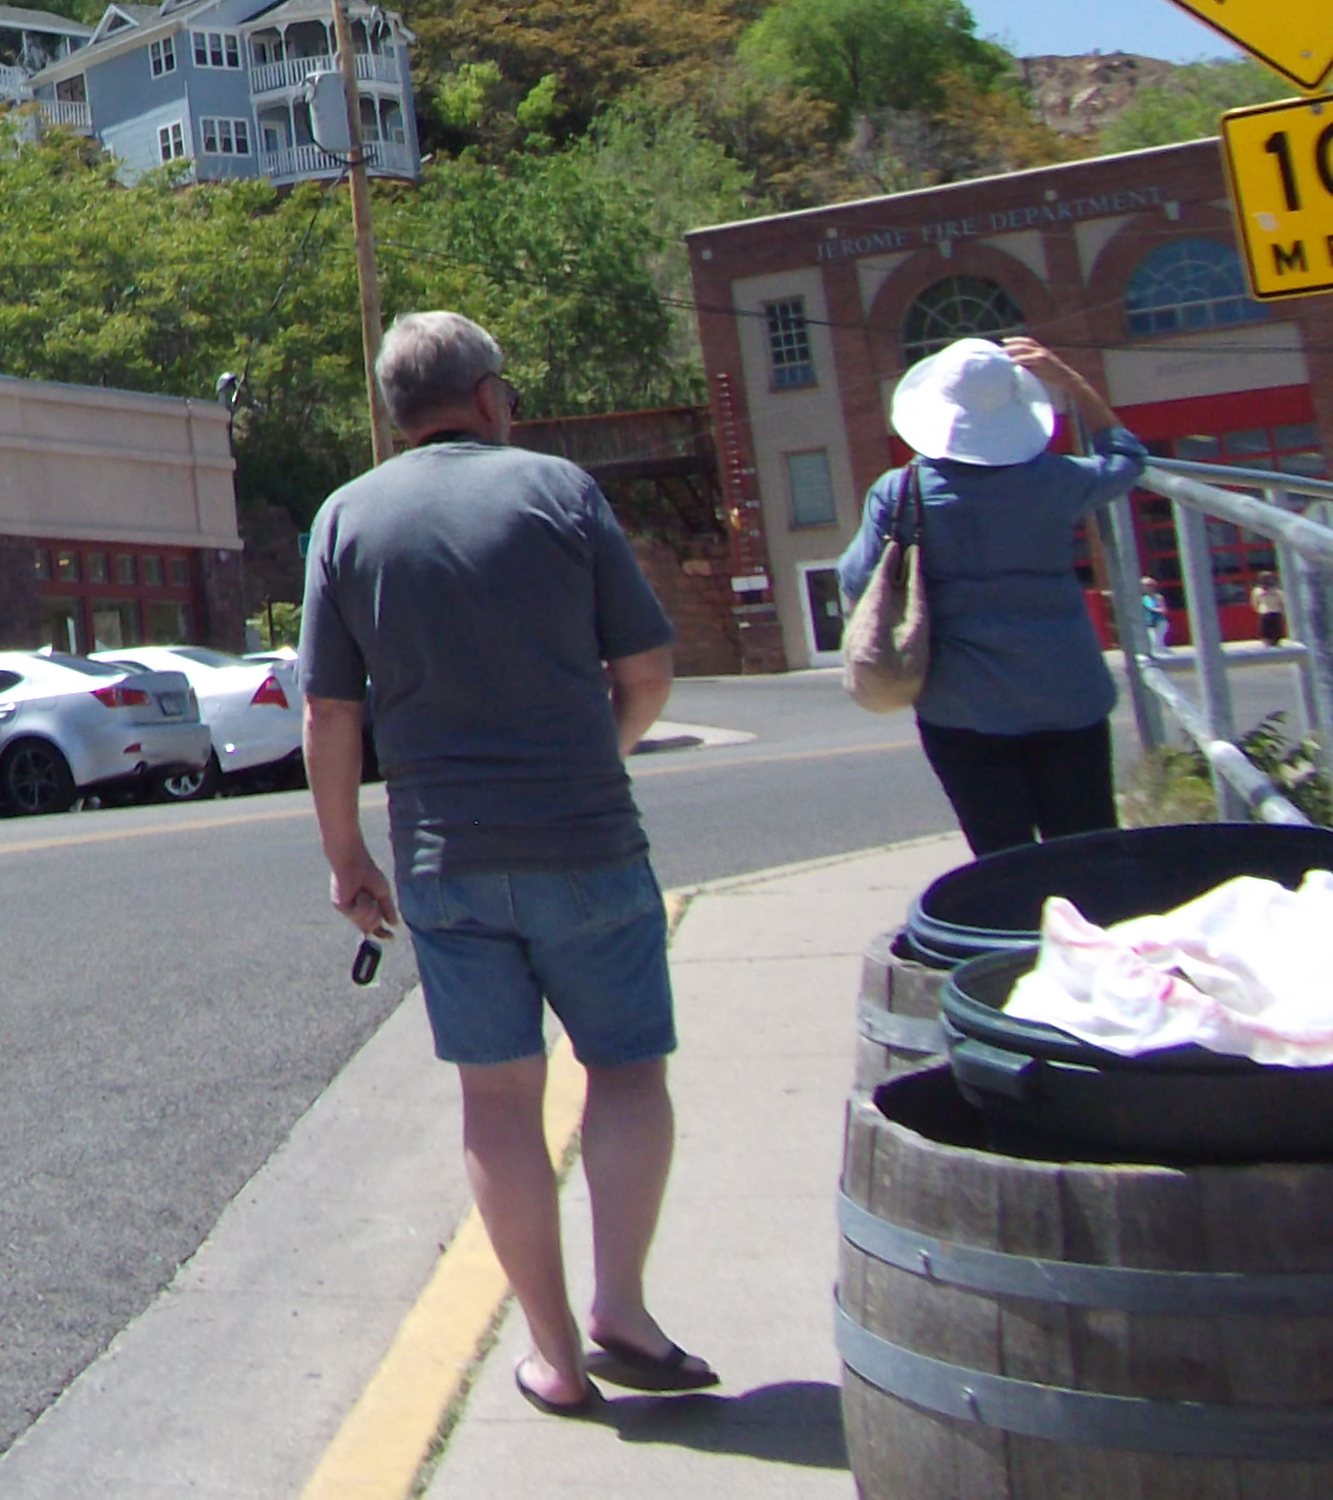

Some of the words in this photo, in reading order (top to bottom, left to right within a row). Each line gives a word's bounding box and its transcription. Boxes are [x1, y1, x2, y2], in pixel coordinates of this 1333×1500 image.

[816, 229, 909, 261] JEROME
[922, 218, 980, 243] FIRE
[990, 187, 1164, 232] DEPARTMENT
